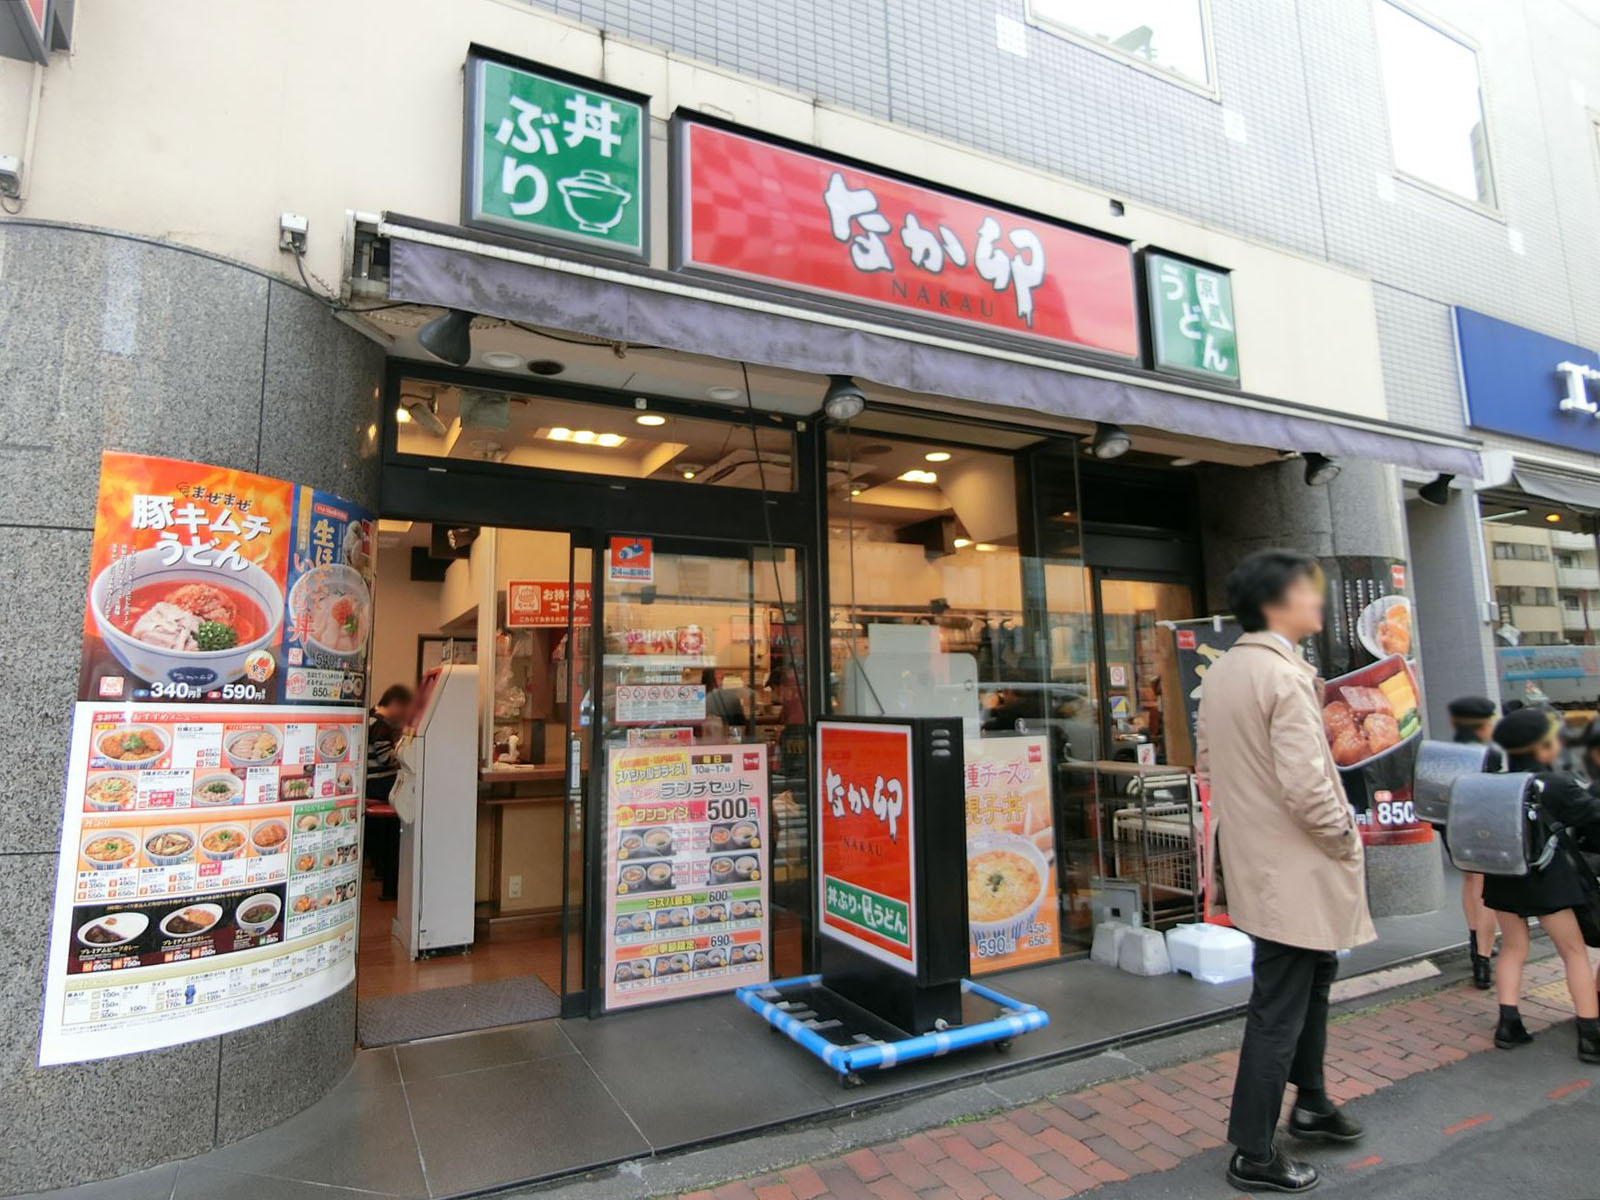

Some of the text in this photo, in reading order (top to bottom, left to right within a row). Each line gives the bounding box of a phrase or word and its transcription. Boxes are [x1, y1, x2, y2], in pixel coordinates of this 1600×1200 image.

[563, 94, 621, 157] 丼
[495, 95, 559, 216] ぶり
[890, 278, 996, 319] NAKAU
[131, 494, 272, 542] 豚キムチ
[155, 531, 250, 572] うどん
[661, 778, 753, 799] ランチセット
